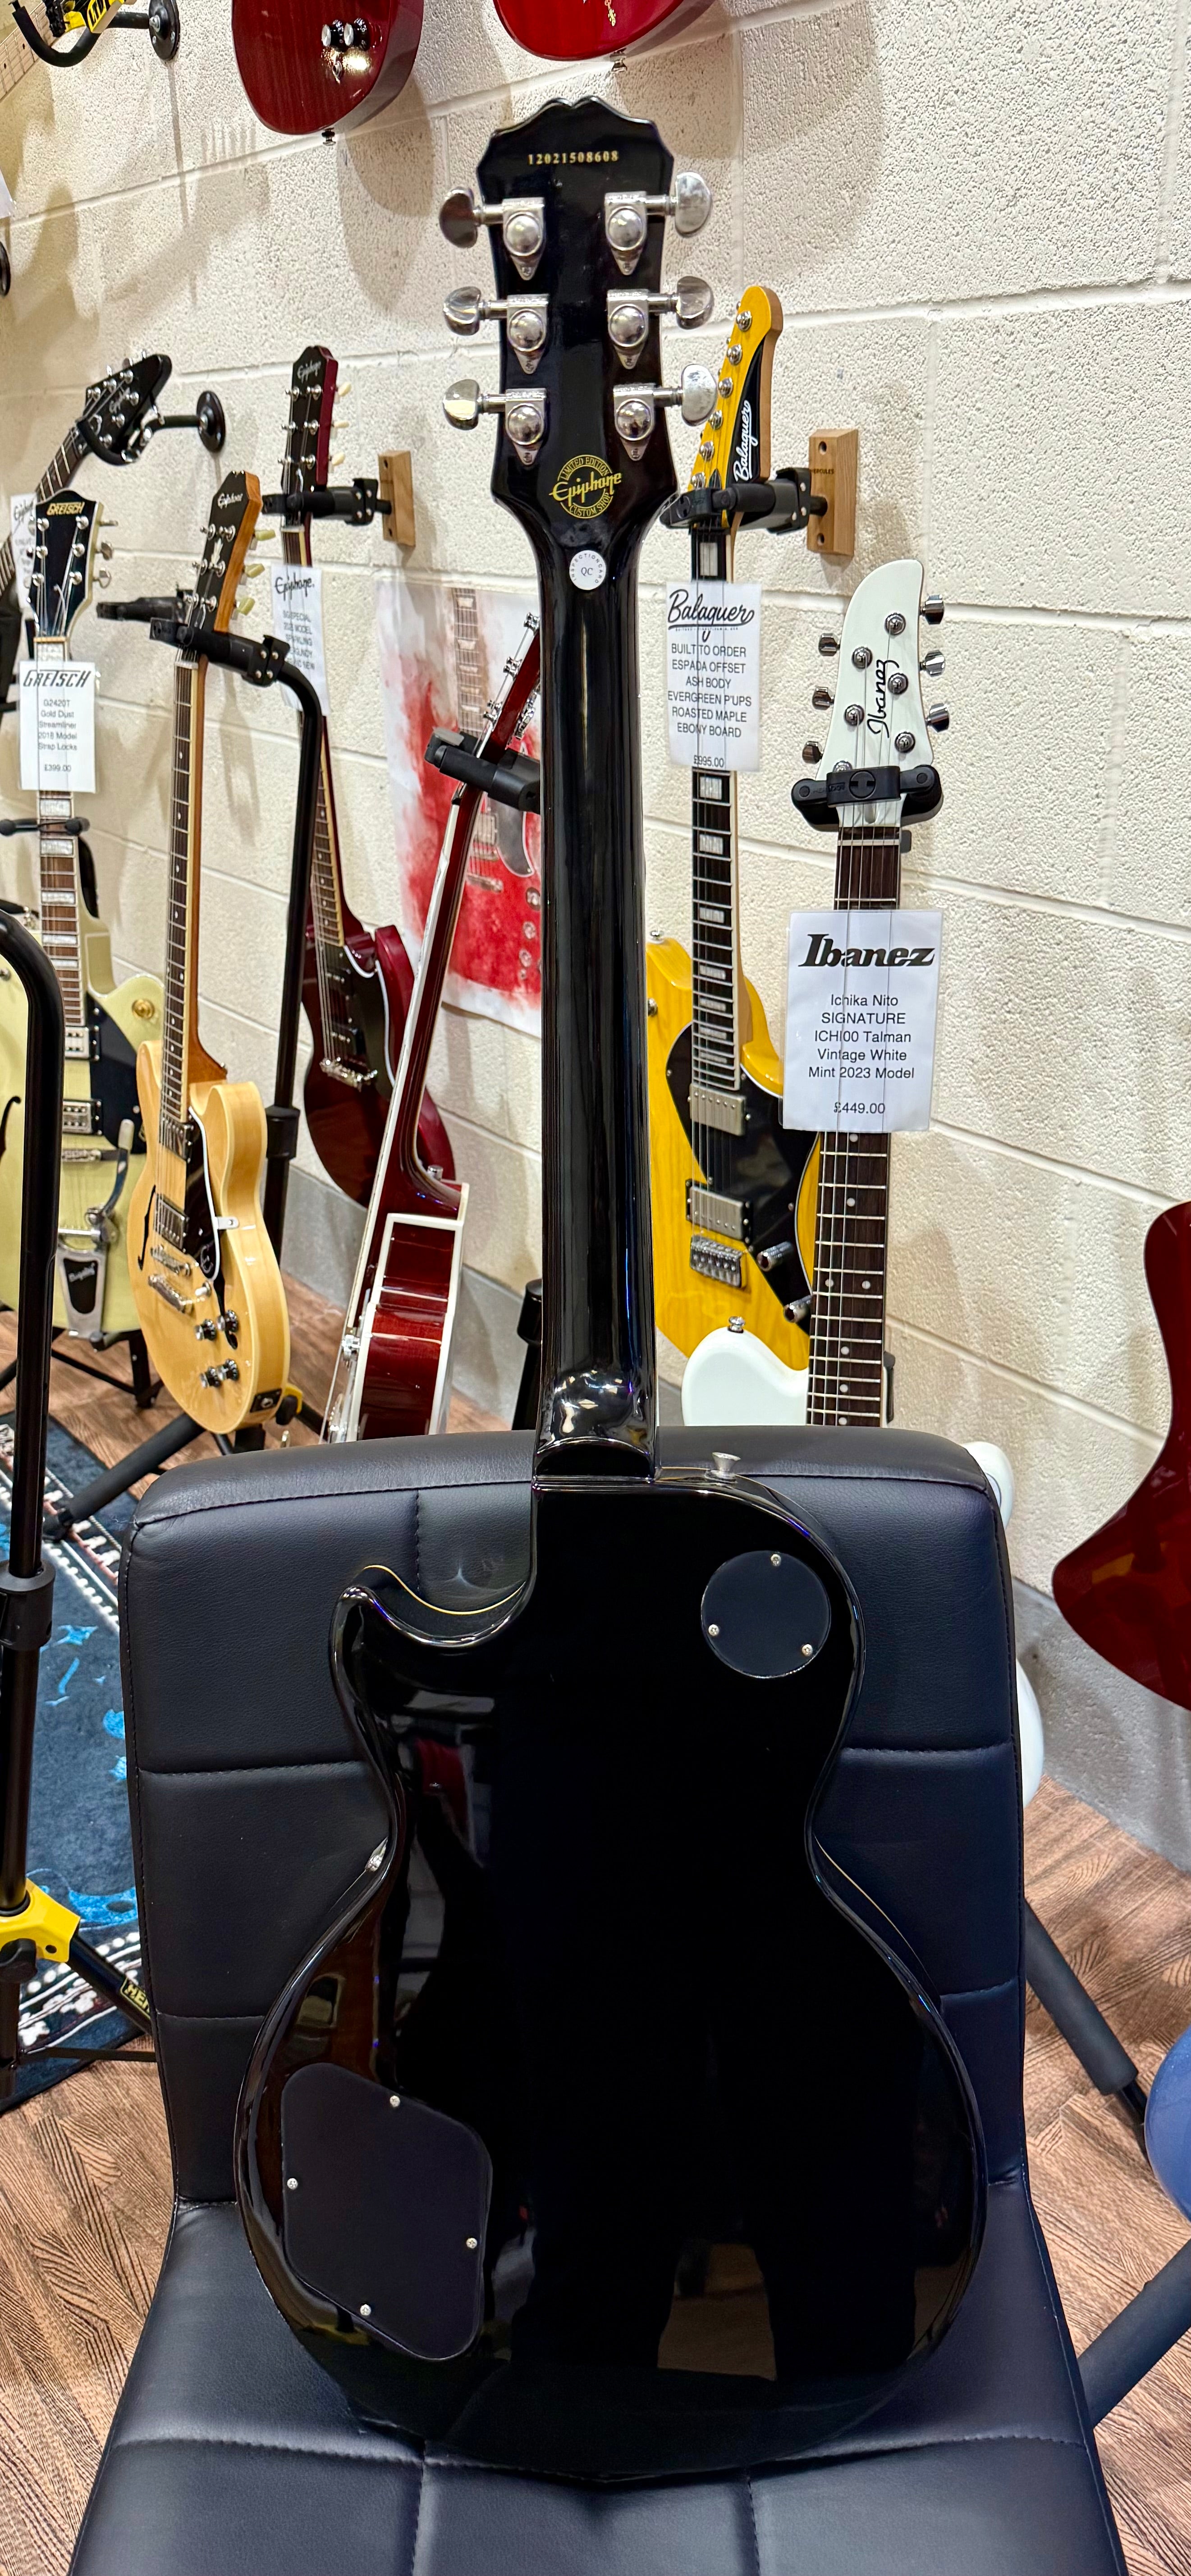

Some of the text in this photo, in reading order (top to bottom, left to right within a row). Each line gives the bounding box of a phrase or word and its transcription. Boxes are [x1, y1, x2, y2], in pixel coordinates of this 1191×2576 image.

[528, 150, 619, 165] 12021508608
[733, 400, 758, 482] Balaguer
[560, 457, 609, 480] LIMITED EDITION
[549, 471, 621, 507] Epiphone
[46, 502, 85, 515] GRETSCH
[570, 492, 611, 517] CUSTOM SHOP
[581, 567, 593, 577] QC
[275, 572, 315, 601] Epiphone
[668, 589, 755, 642] Balaguer
[672, 643, 747, 657] BUILT TO ORDER
[672, 659, 746, 673] ESPADA OFFSET
[23, 669, 92, 687] GRETSCH
[686, 676, 731, 689] ASH BODY
[668, 691, 752, 706] EVERGREEN P'UPS
[867, 659, 899, 738] Ibanez
[41, 709, 74, 718] Gold Dust
[672, 707, 747, 722] ROASTED MAPLE
[56, 731, 77, 740] Model
[677, 722, 742, 738] EBONY BOARD
[694, 754, 724, 768] £995.00
[798, 934, 935, 967] Ibanez
[831, 994, 898, 1006] Ichika Nito
[821, 1013, 906, 1024] SIGNATURE
[863, 1031, 911, 1043] Talman
[818, 1049, 907, 1063] Vintage White
[809, 1067, 914, 1078] Mint 2023 Model
[834, 1103, 885, 1114] £449.00
